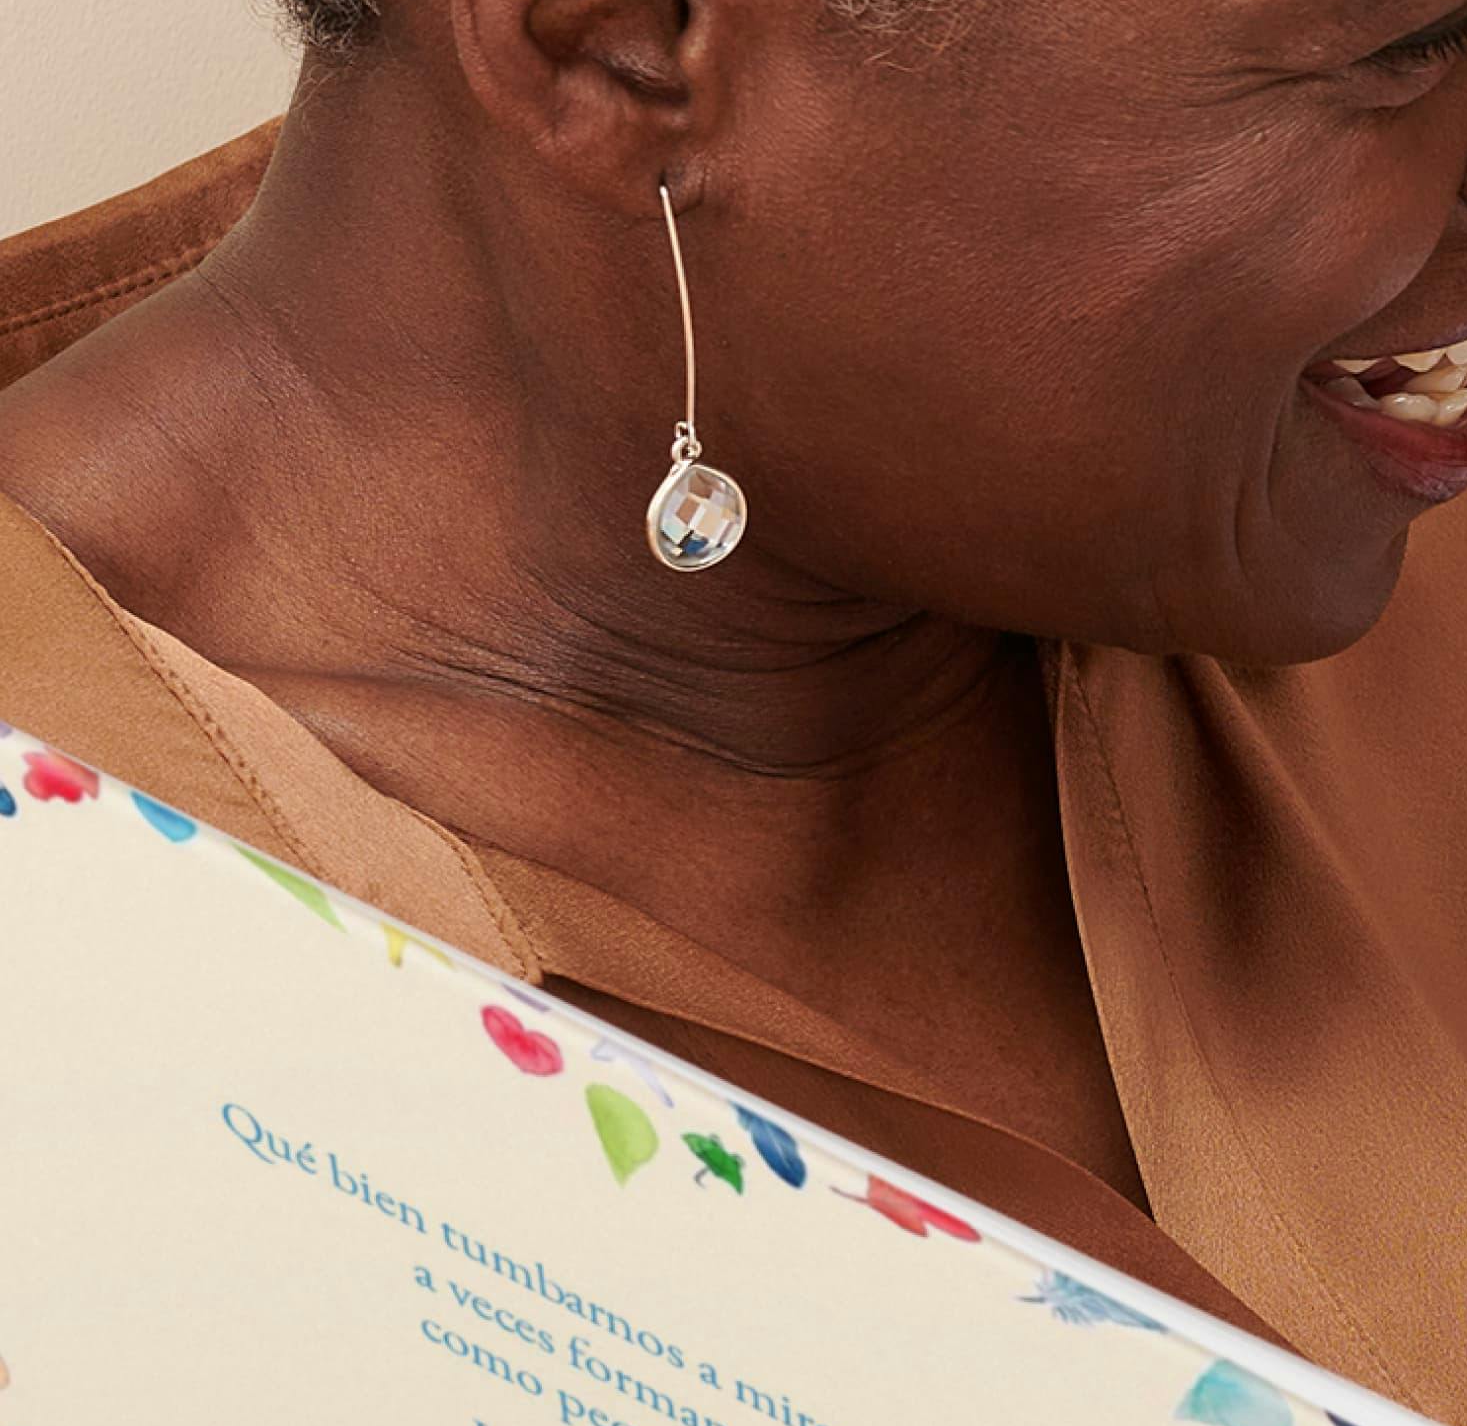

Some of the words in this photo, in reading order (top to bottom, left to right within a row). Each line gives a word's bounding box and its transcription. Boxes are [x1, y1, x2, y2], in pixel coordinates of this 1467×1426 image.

[220, 1102, 318, 1176] Qué
[328, 1152, 427, 1235] bien
[440, 1222, 686, 1370] tumbarnos
[699, 1363, 721, 1391] a
[415, 1266, 438, 1295] a
[448, 1280, 555, 1356] veces
[420, 1319, 544, 1397] como
